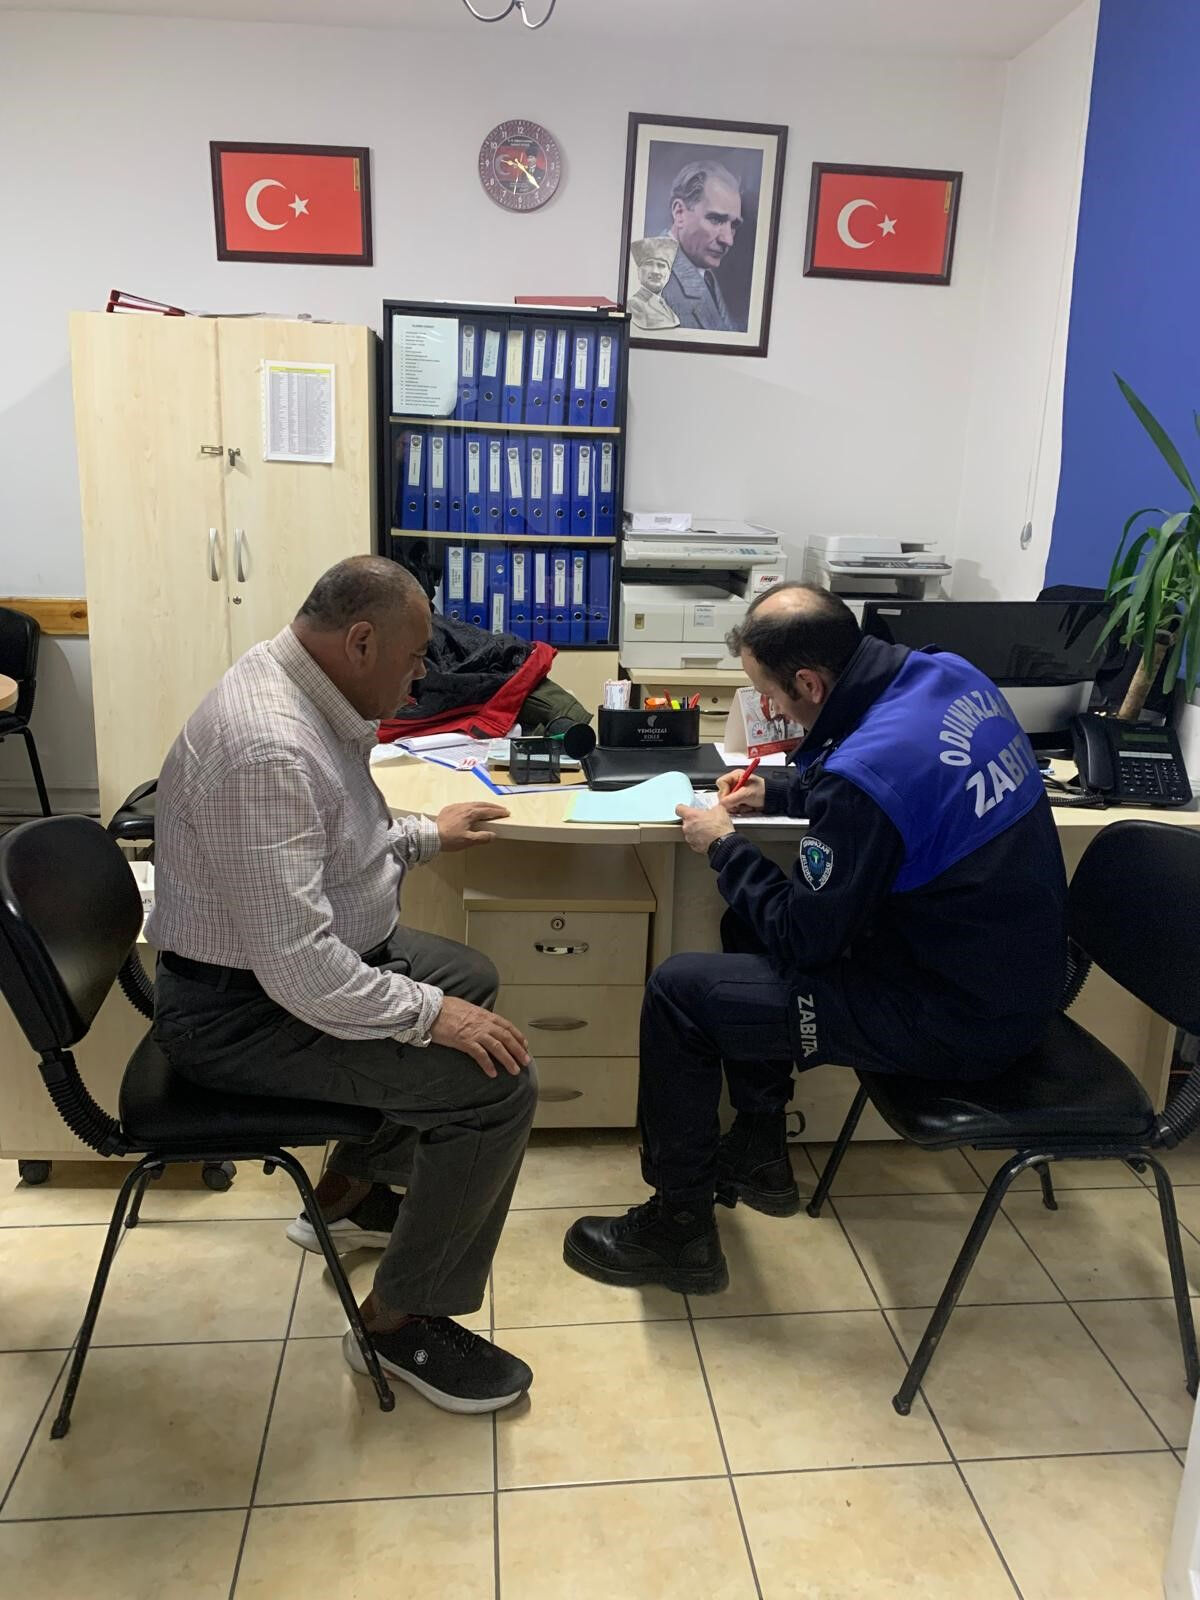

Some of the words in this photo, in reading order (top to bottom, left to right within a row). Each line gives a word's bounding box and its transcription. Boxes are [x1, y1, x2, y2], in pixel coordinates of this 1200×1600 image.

[939, 690, 1006, 767] ODUNPAZA
[965, 733, 1034, 819] ZABIT
[798, 994, 818, 1058] ZABITA
